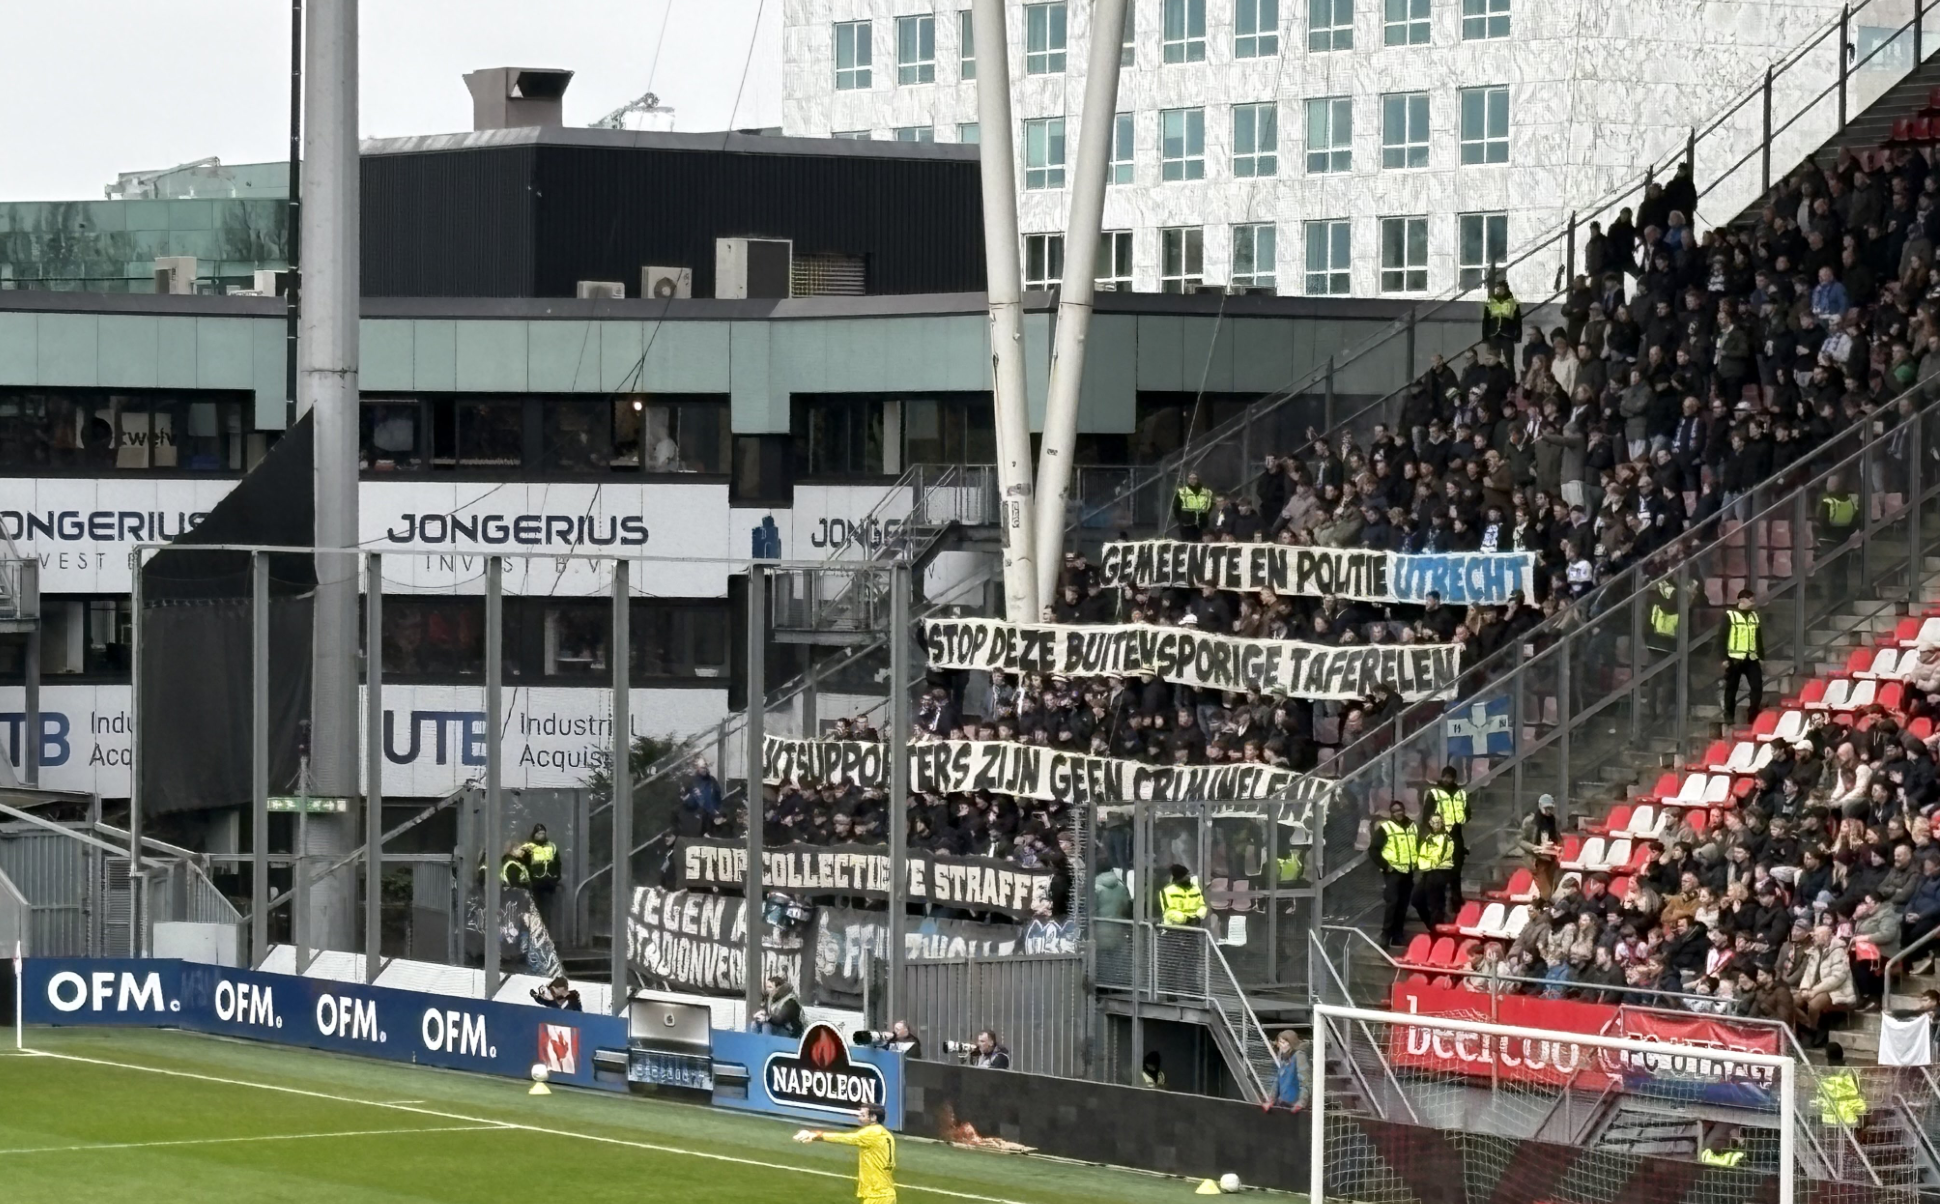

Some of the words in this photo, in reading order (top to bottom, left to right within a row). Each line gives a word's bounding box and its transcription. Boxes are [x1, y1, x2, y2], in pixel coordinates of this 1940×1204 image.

[387, 513, 649, 545] JONGERIUS
[1101, 543, 1243, 588] GEMEENTE
[1250, 547, 1288, 592] EN
[1297, 551, 1387, 597] POLITIE
[1394, 555, 1529, 601] UTRECHT
[927, 623, 989, 666] STOP
[985, 626, 1057, 672] DEZE
[1291, 647, 1455, 696] TAFERELEN
[519, 712, 638, 737] Industril
[972, 748, 1041, 796] ZIJN
[1050, 754, 1125, 803] GEEN
[685, 845, 747, 883] STOP
[762, 851, 927, 897] COLLECTIEE
[772, 1065, 877, 1104] NAPOLEON
